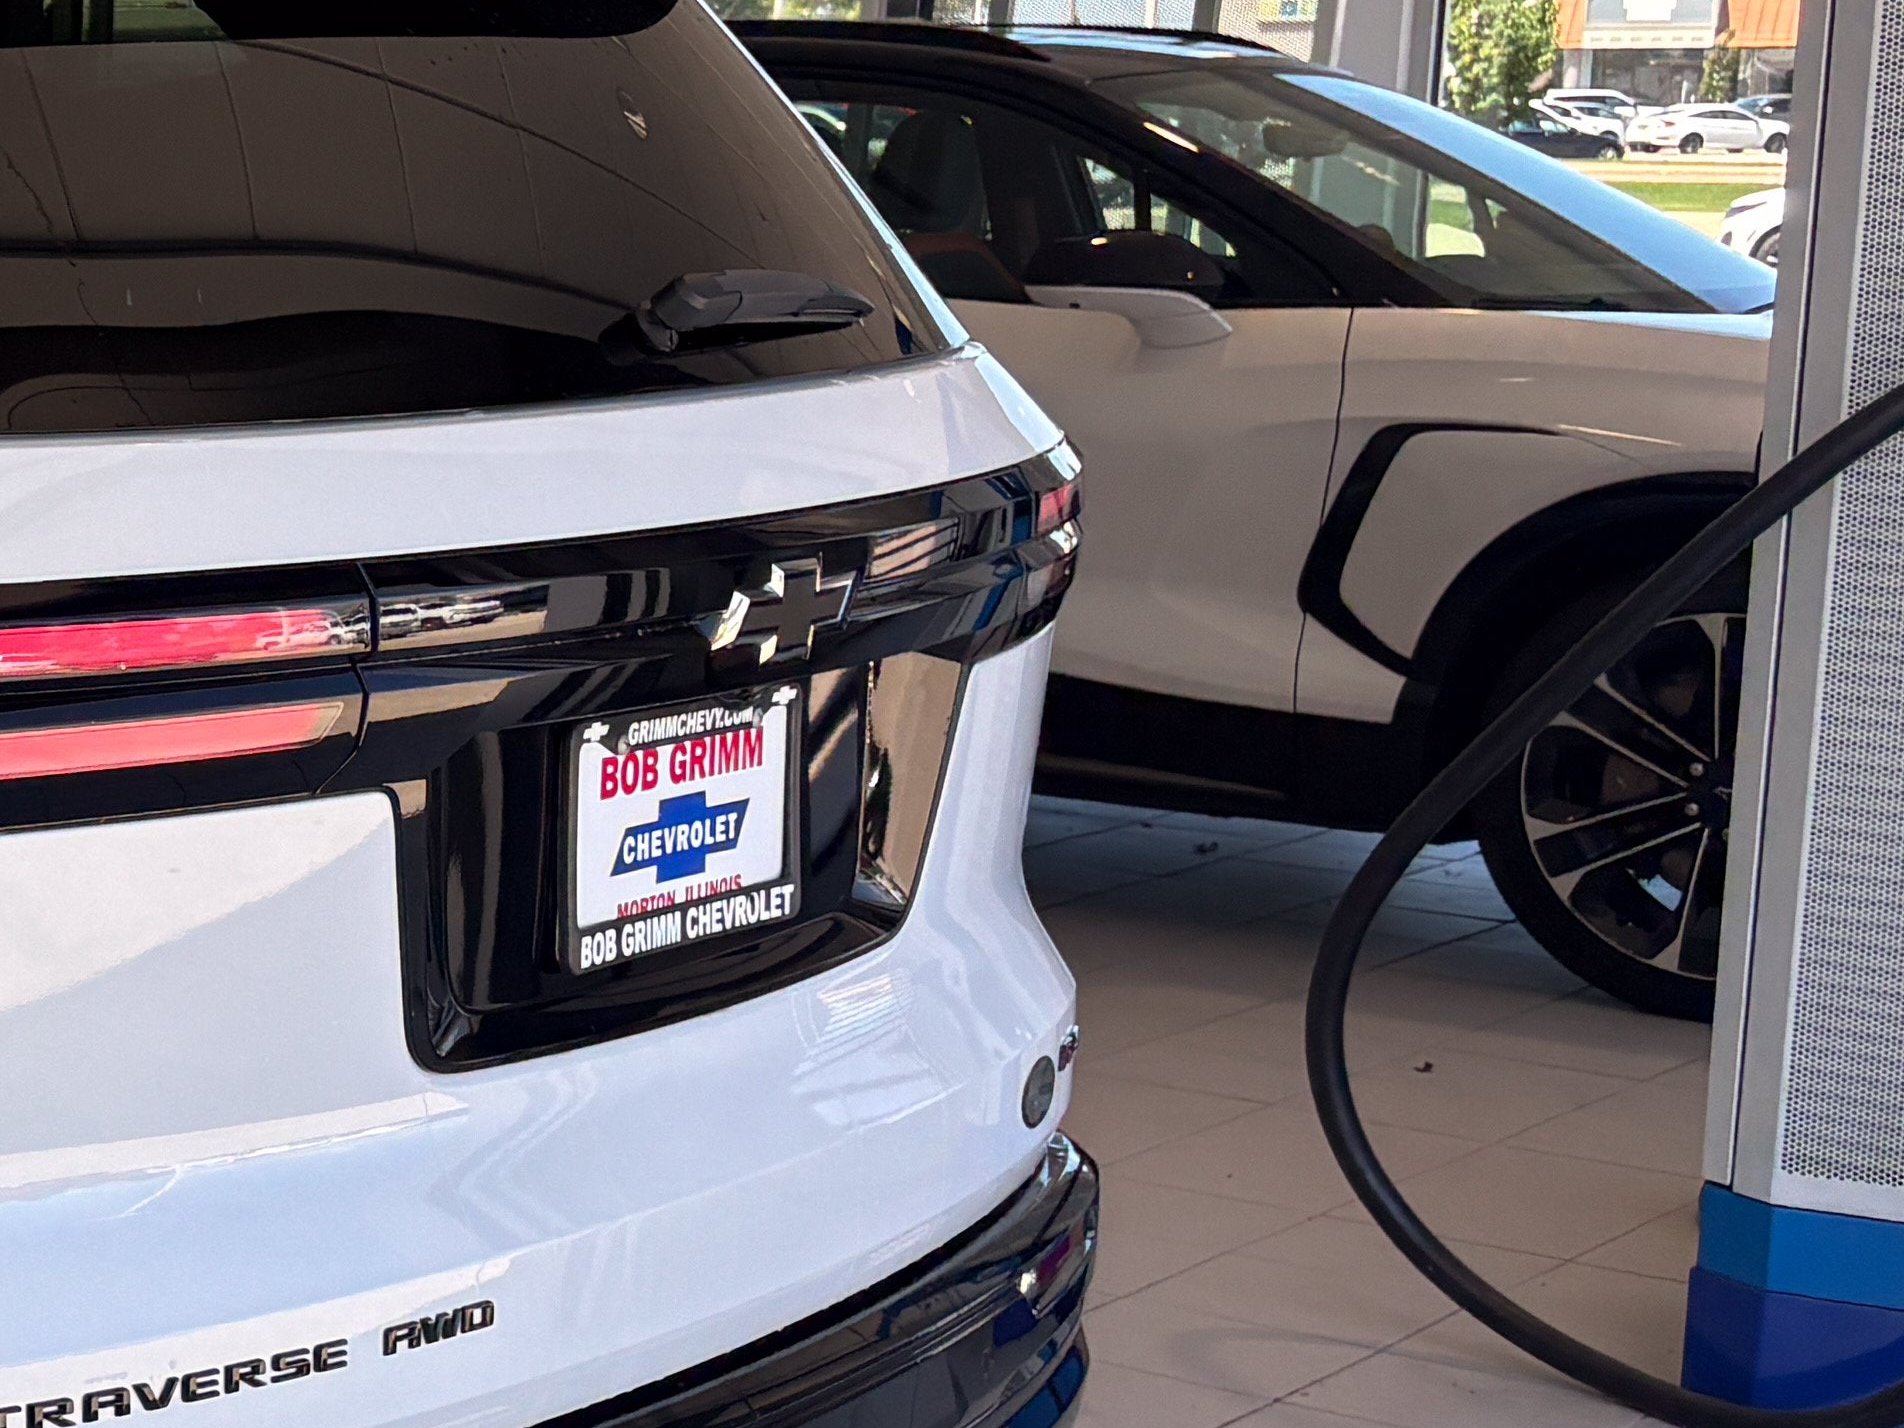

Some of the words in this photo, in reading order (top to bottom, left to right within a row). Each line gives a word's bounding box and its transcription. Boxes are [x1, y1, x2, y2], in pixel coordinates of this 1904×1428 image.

[600, 749, 659, 801] BOB
[669, 726, 765, 786] GRIMM
[623, 813, 738, 864] CHEVROLET
[580, 928, 617, 969] BOB
[621, 910, 681, 957] GRIMM
[686, 884, 795, 939] CHEVROLET
[617, 890, 676, 918] MORTON
[382, 1299, 495, 1357] AWD
